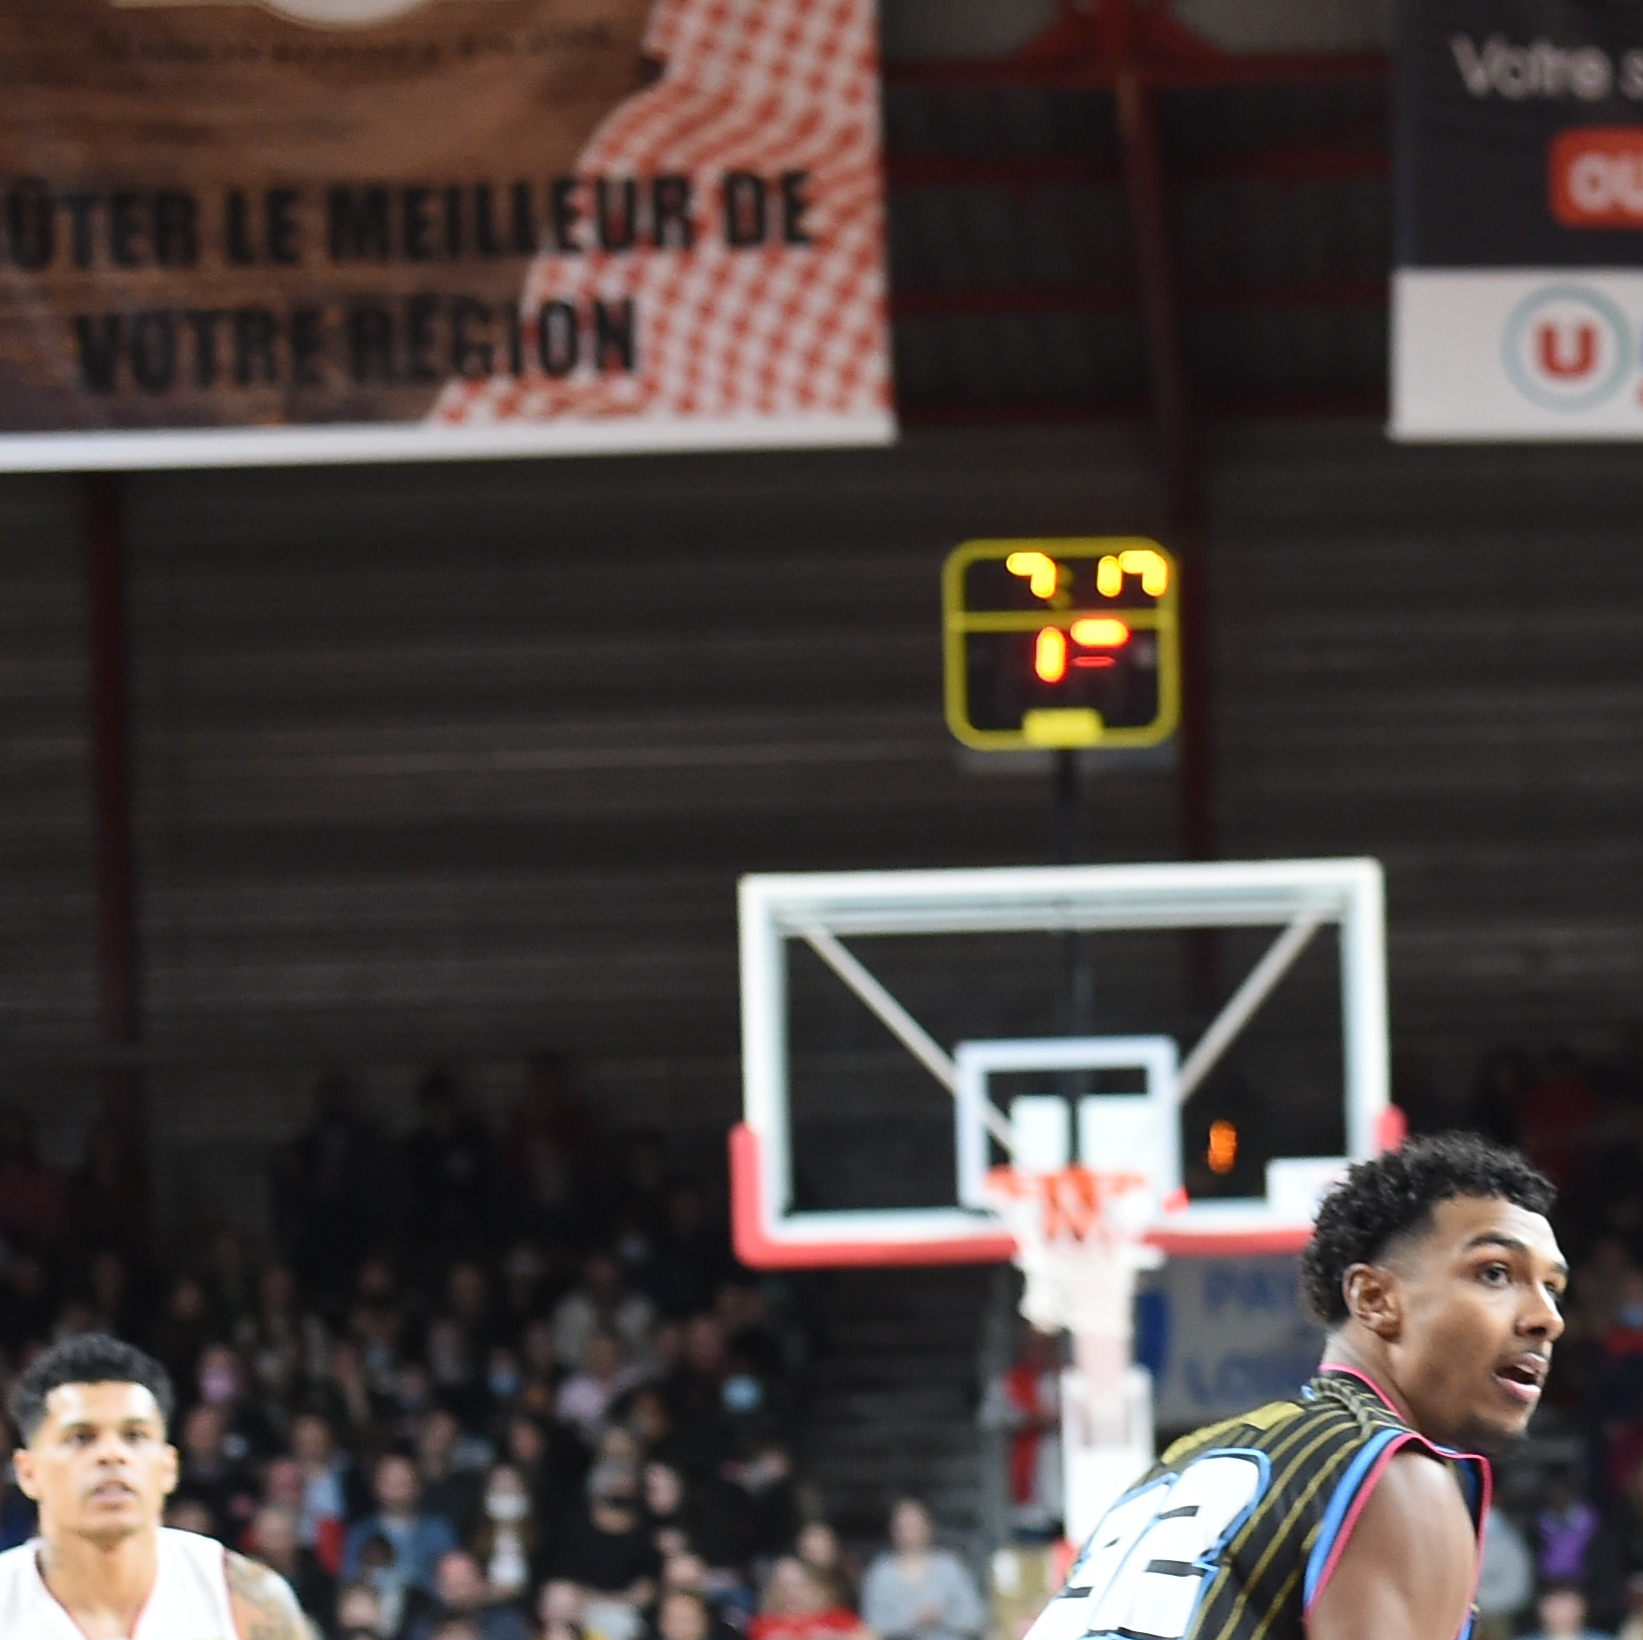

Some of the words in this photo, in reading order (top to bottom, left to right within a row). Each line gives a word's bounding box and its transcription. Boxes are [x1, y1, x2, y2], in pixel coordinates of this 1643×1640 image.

[1450, 32, 1613, 99] Votre
[225, 186, 300, 265] LE
[328, 172, 698, 260] MEILLEUR
[722, 169, 815, 248] DE
[76, 303, 325, 391] VOTRE
